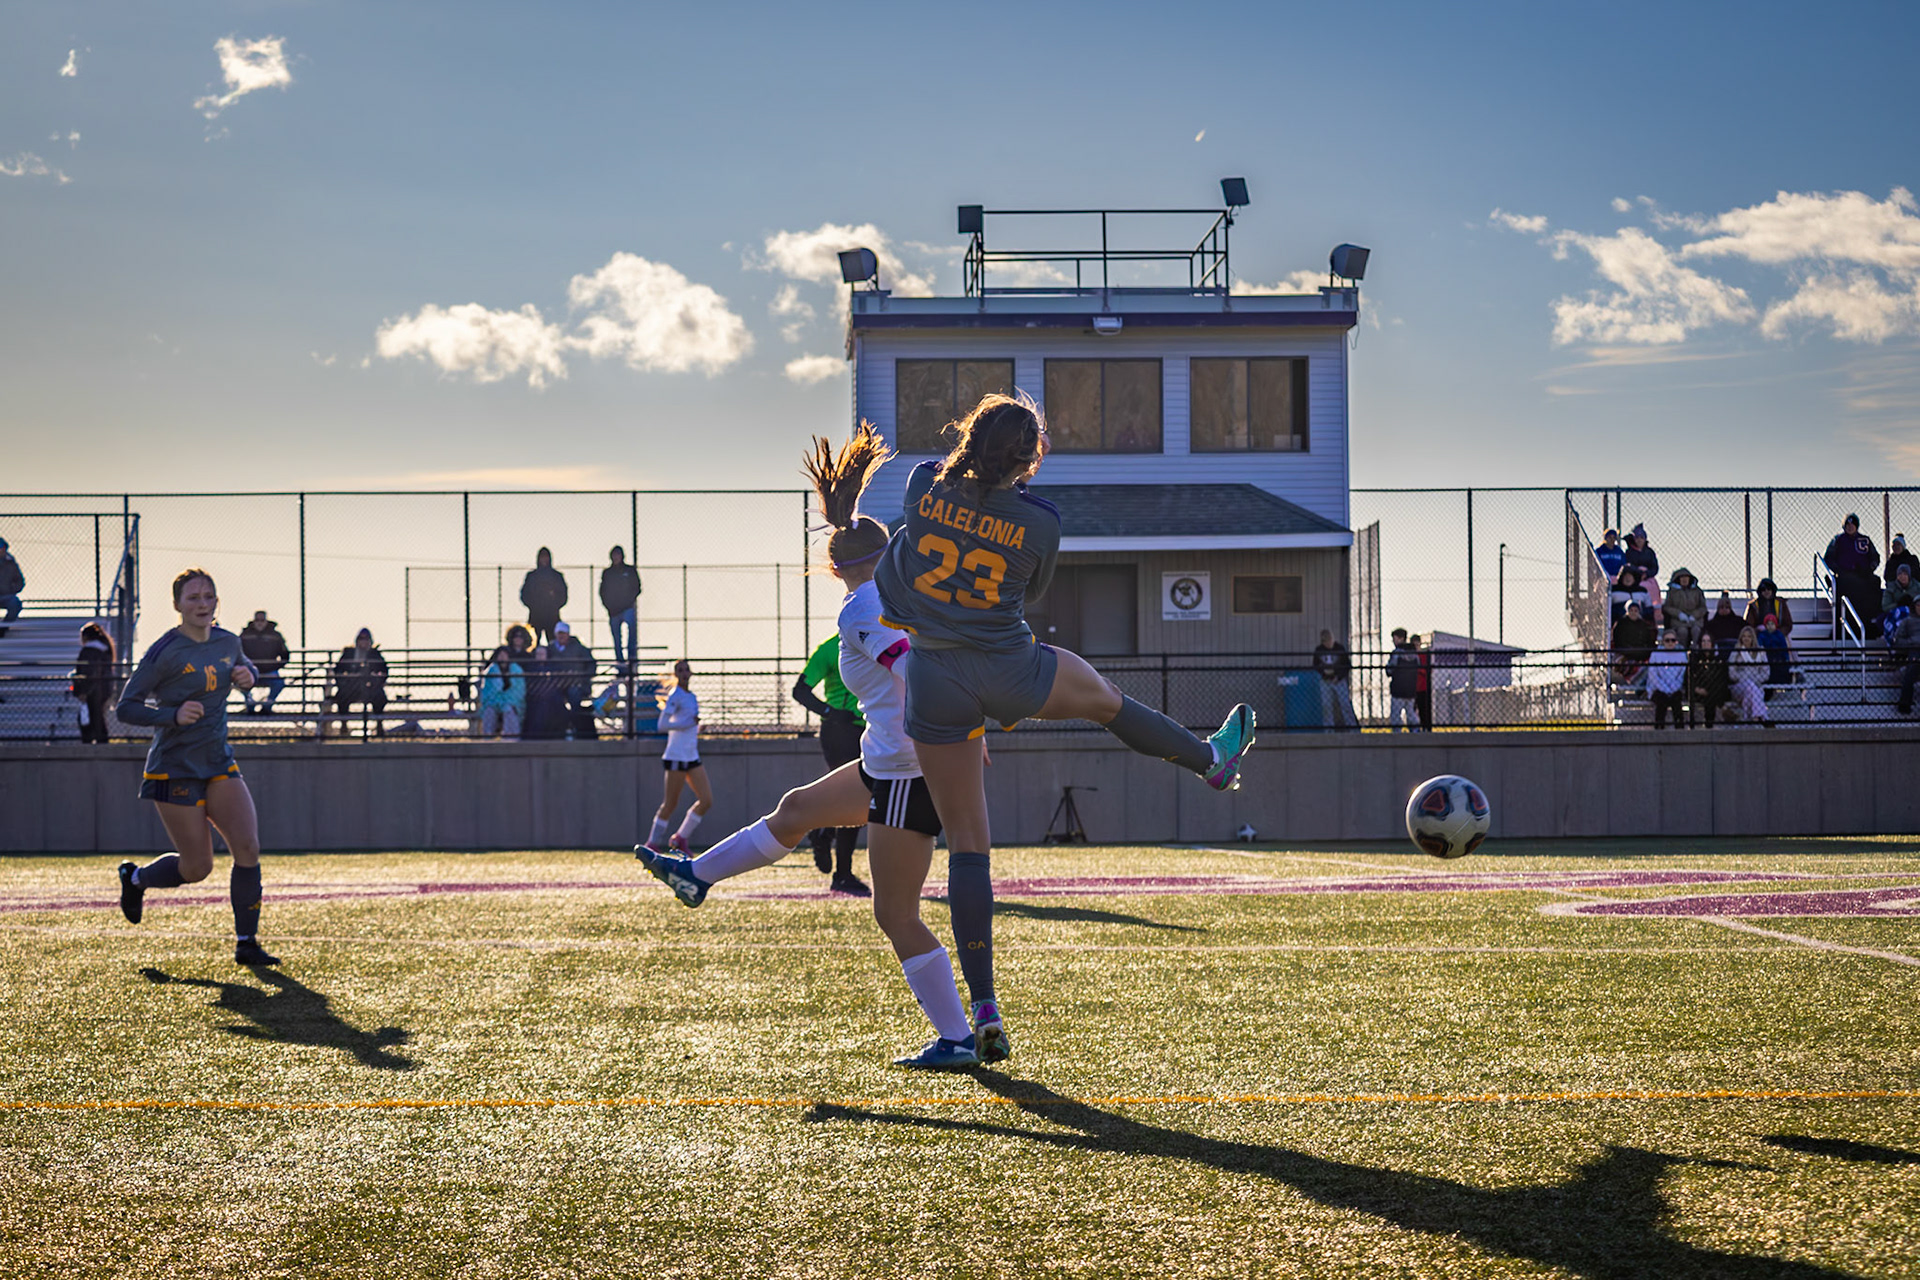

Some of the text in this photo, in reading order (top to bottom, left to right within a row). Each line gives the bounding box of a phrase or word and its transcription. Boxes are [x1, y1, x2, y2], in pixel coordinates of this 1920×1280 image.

[918, 493, 1026, 549] CALEDONIA
[913, 533, 1007, 609] 23
[204, 665, 217, 691] 16
